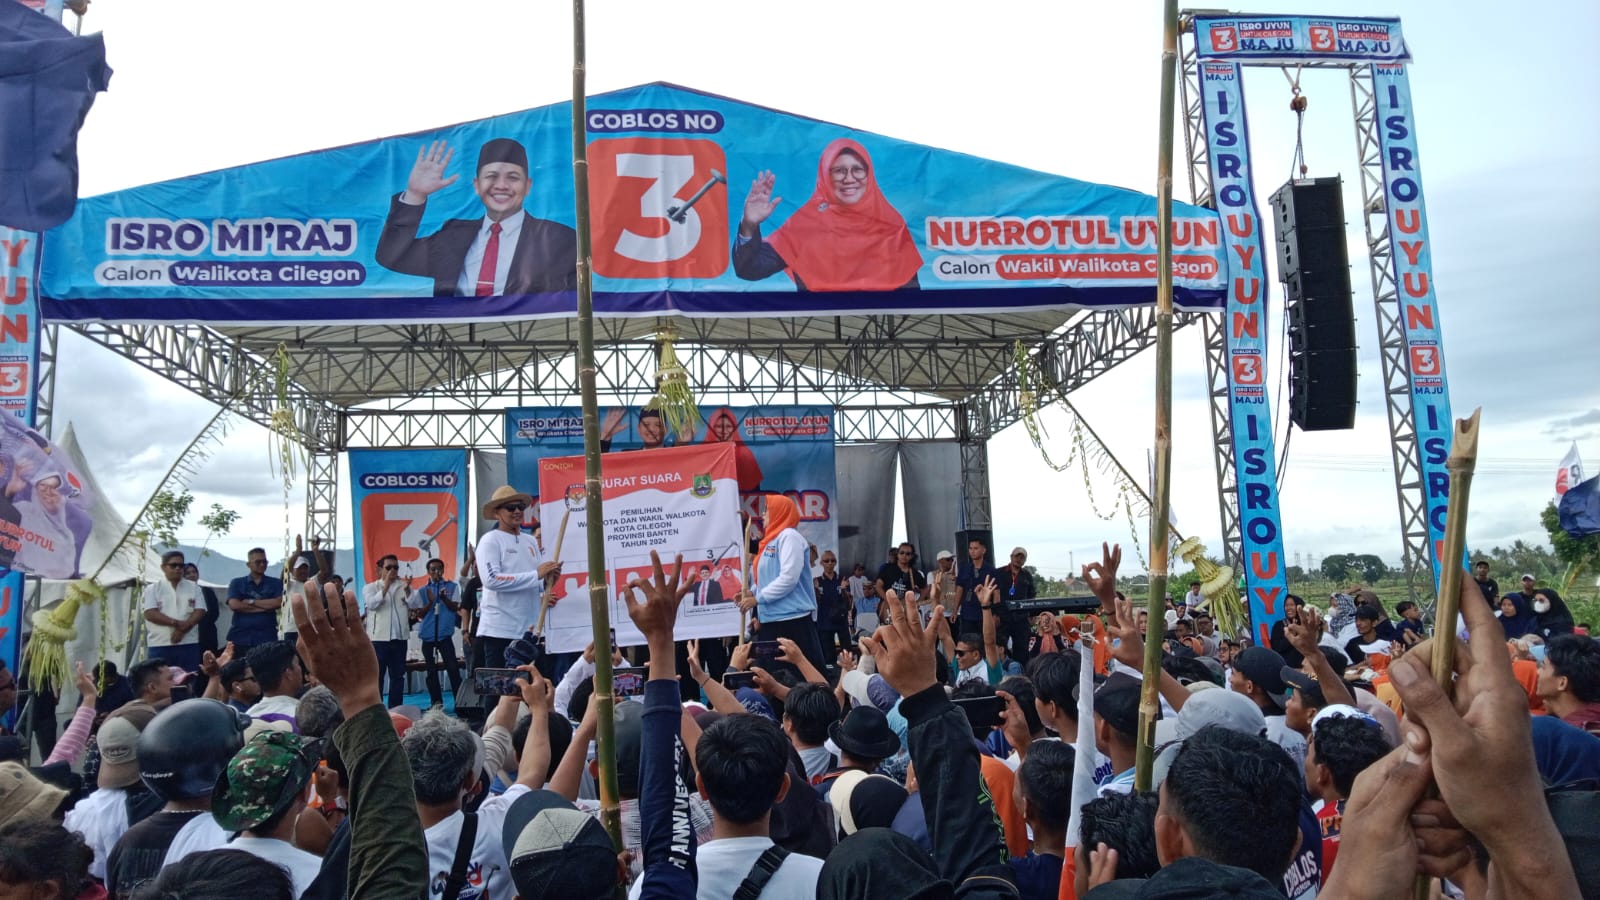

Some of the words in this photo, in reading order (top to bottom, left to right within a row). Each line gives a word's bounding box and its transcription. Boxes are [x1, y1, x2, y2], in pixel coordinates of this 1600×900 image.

[1239, 22, 1261, 30] ISRO
[1264, 22, 1290, 30] UYUN
[1338, 23, 1360, 31] ISRO
[1362, 24, 1388, 33] UYUN
[1214, 29, 1234, 50] 3
[1240, 38, 1294, 50] MAJU
[1314, 28, 1331, 49] 3
[1338, 38, 1391, 53] MAJU
[1205, 73, 1234, 81] MAJU
[1376, 68, 1404, 76] MAJU
[589, 113, 679, 129] COBLOS
[684, 113, 717, 130] NO
[1214, 90, 1248, 207] ISRO
[1385, 85, 1419, 203] ISRO
[614, 153, 702, 263] 3
[110, 222, 205, 251] ISRO
[217, 222, 352, 251] MI'RAJ
[929, 219, 1116, 247] NURROTUL
[102, 265, 161, 281] Calon
[174, 264, 272, 282] Walikota
[278, 264, 360, 285] Cilegon
[939, 260, 990, 275] Calon
[1001, 257, 1054, 273] Wakil
[1059, 256, 1141, 274] Walikota
[1143, 259, 1213, 274] Cegon
[1395, 209, 1434, 330] UYUN
[1226, 213, 1259, 339] UYUN
[0, 238, 29, 343] YUN
[1416, 349, 1435, 372] 3
[1238, 358, 1257, 382] 3
[0, 366, 21, 393] 3
[1415, 386, 1444, 395] MAJU
[1235, 396, 1265, 405] MAJU
[519, 419, 545, 429] ISRO
[745, 417, 798, 427] NURROTUL
[801, 416, 829, 425] UYUN
[543, 463, 573, 471] CONTOH
[364, 475, 428, 487] COBLOS
[432, 474, 454, 486] NO
[640, 472, 682, 485] SUARA
[1243, 414, 1277, 545] ISRO
[577, 518, 619, 528] WOTA
[620, 516, 637, 525] DAN
[639, 513, 664, 523] WAKIL
[665, 509, 706, 520] WALIKOTA
[620, 506, 663, 516] PEMILIHAN
[607, 532, 645, 541] PROVINSI
[646, 528, 679, 538] BANTEN
[613, 523, 635, 533] KOTA
[637, 520, 672, 531] CILEGON
[383, 503, 440, 578] 3
[620, 540, 647, 548] TAHUN
[649, 538, 667, 546] 2024
[706, 549, 714, 559] 3
[1283, 850, 1318, 898] COBLOS
